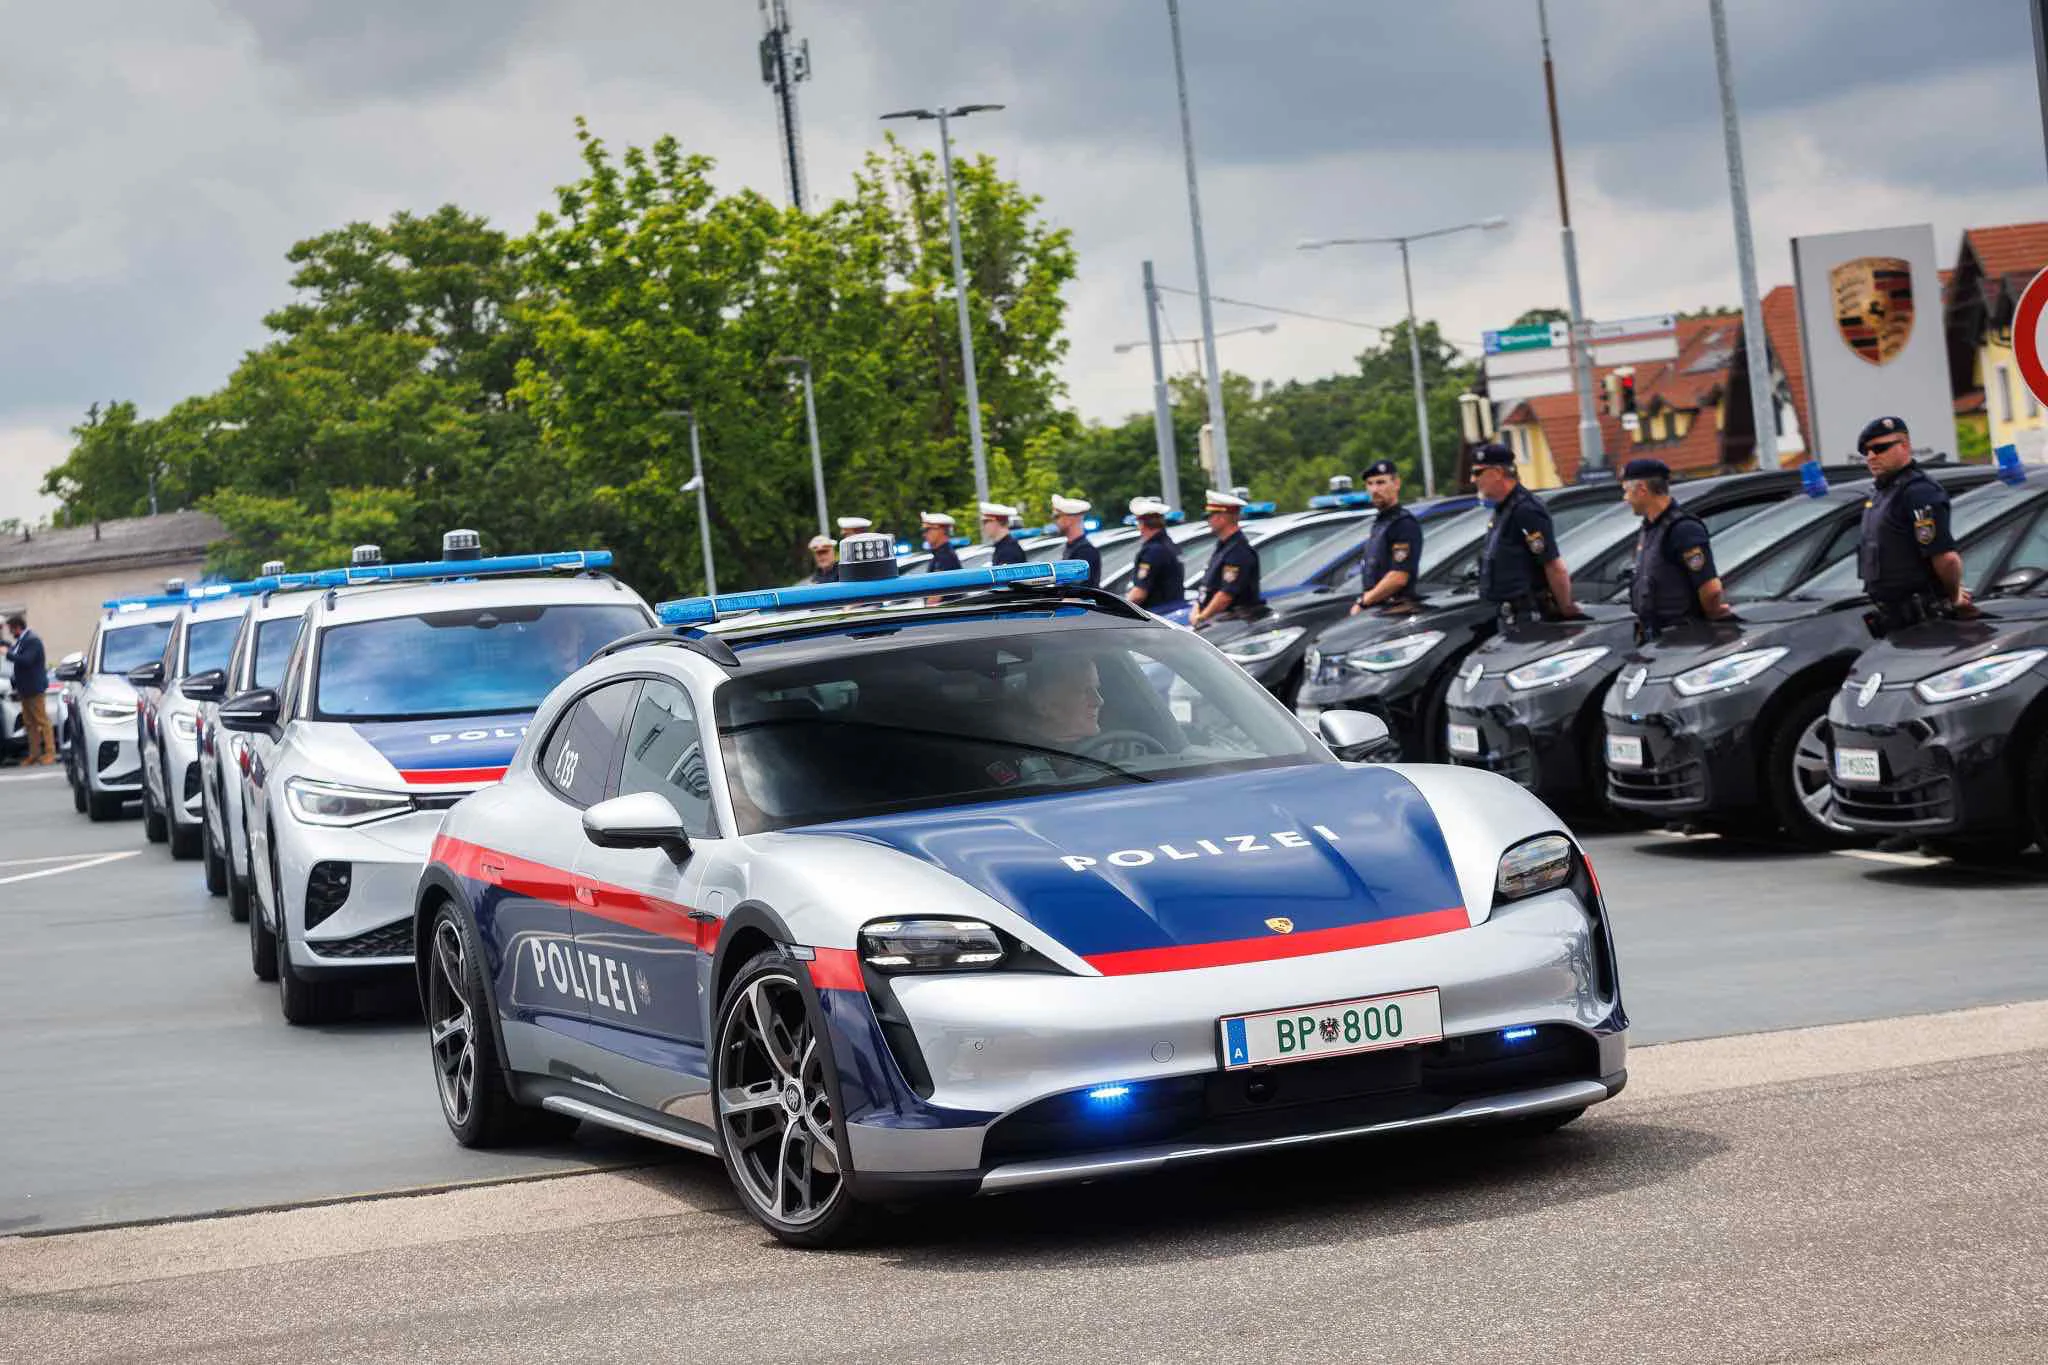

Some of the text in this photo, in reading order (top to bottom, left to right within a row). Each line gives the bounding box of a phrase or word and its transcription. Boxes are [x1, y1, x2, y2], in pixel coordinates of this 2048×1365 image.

[1060, 825, 1341, 872] POLIZEI
[530, 937, 638, 1015] POLIZEI
[1233, 1003, 1403, 1059] A BP 800
